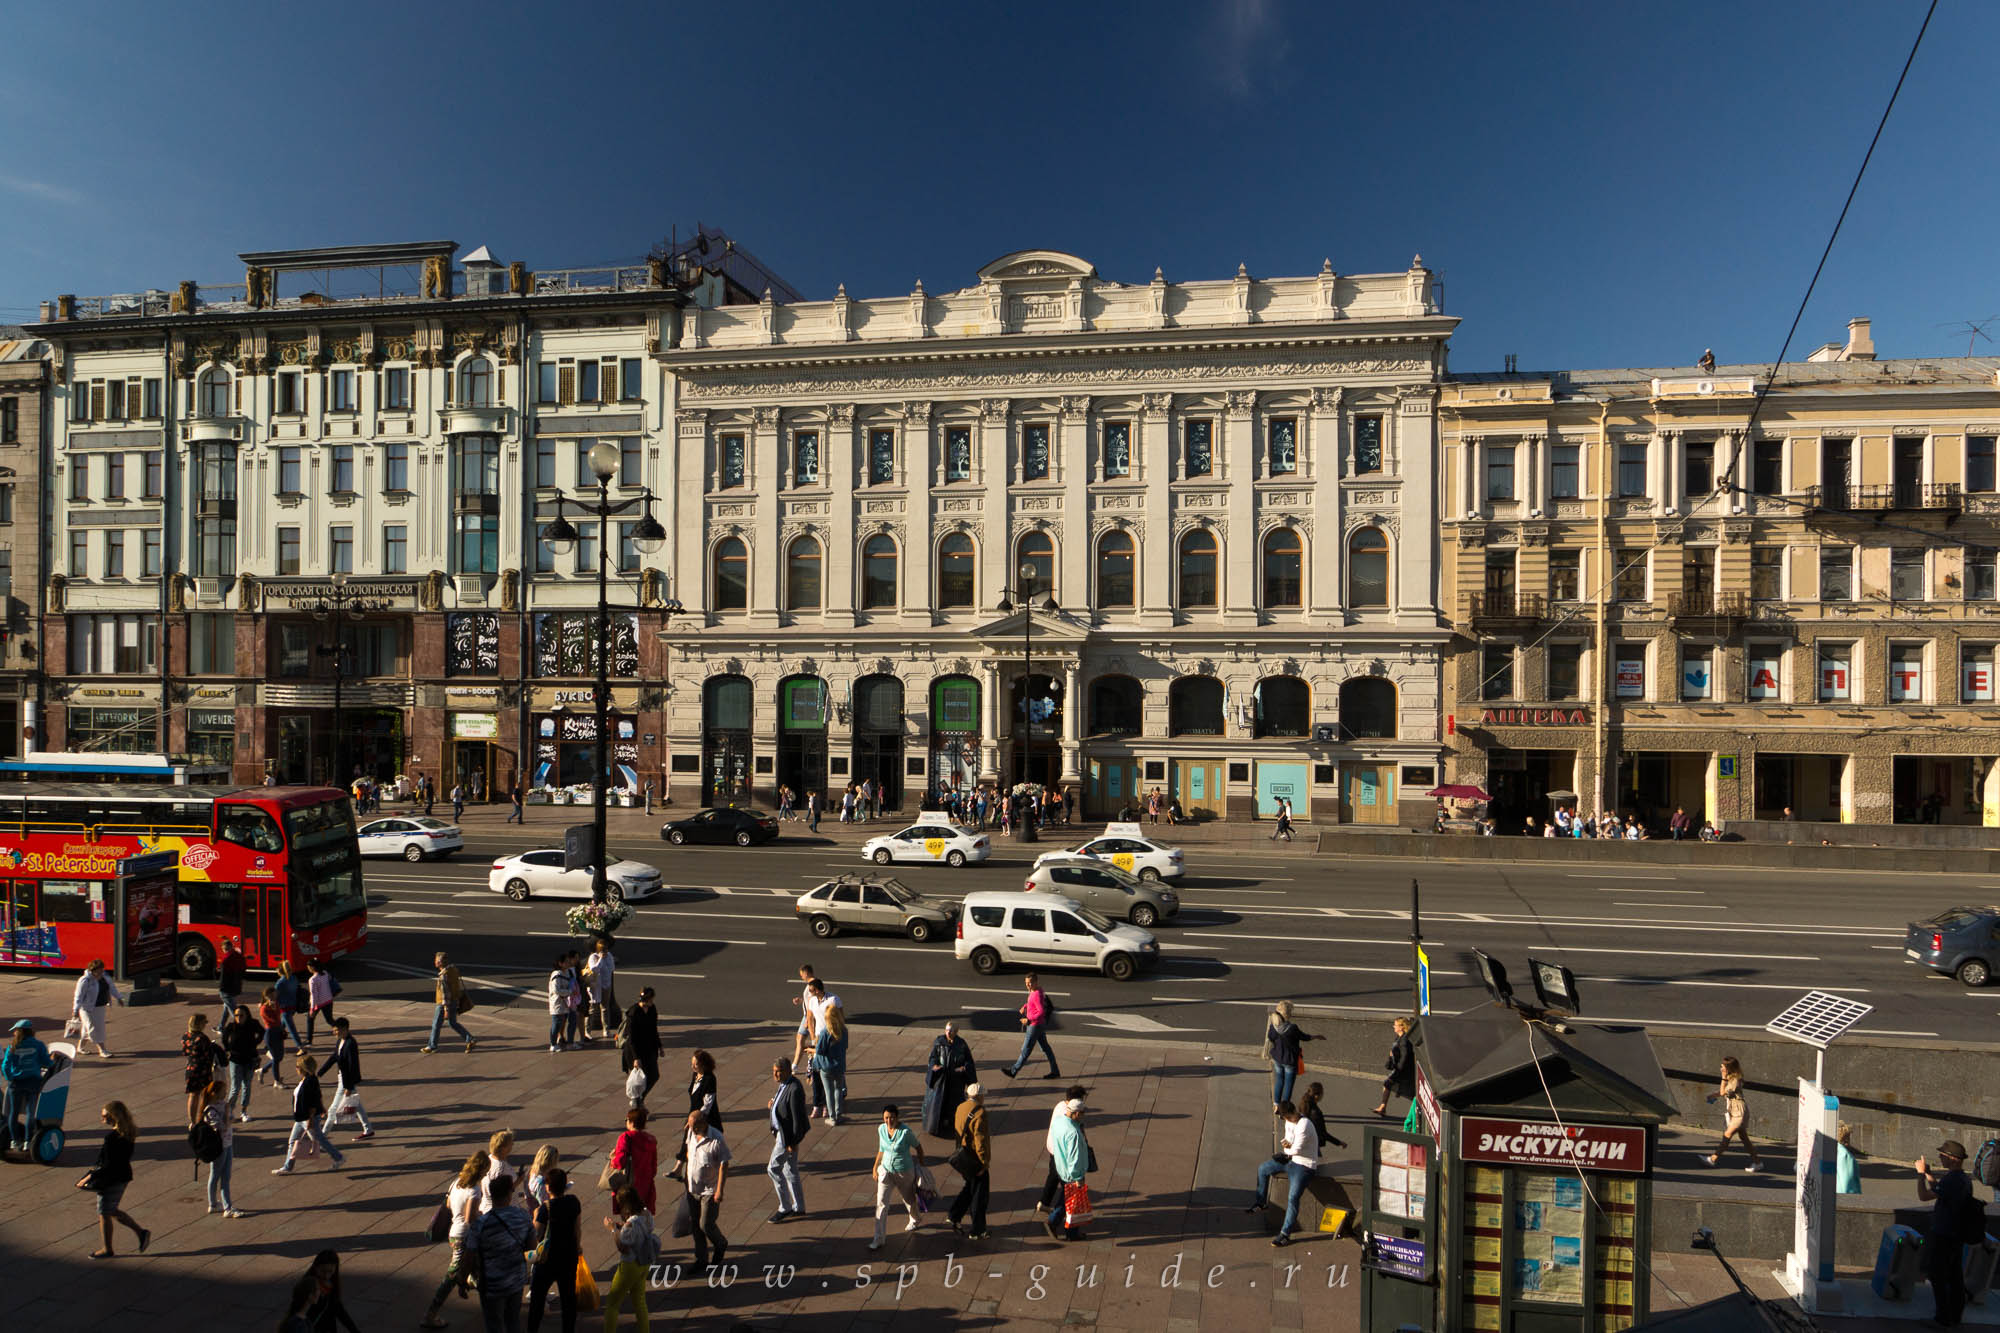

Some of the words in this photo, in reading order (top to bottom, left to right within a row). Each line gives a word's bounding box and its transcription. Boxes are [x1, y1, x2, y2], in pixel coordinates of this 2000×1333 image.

[264, 585, 314, 596] ГОРОДСКАЯ
[472, 687, 496, 695] BOOKS
[555, 690, 598, 702] БУКВО
[1481, 709, 1586, 724] АПТЕКА
[27, 853, 43, 872] St
[45, 853, 117, 873] Petersbur
[184, 851, 217, 865] OFFICIAL
[1520, 1124, 1585, 1138] DAVRANOV
[1478, 1133, 1628, 1161] ЭКСКУРСИИ
[1508, 1154, 1597, 1167] www.davranovtravel.ru
